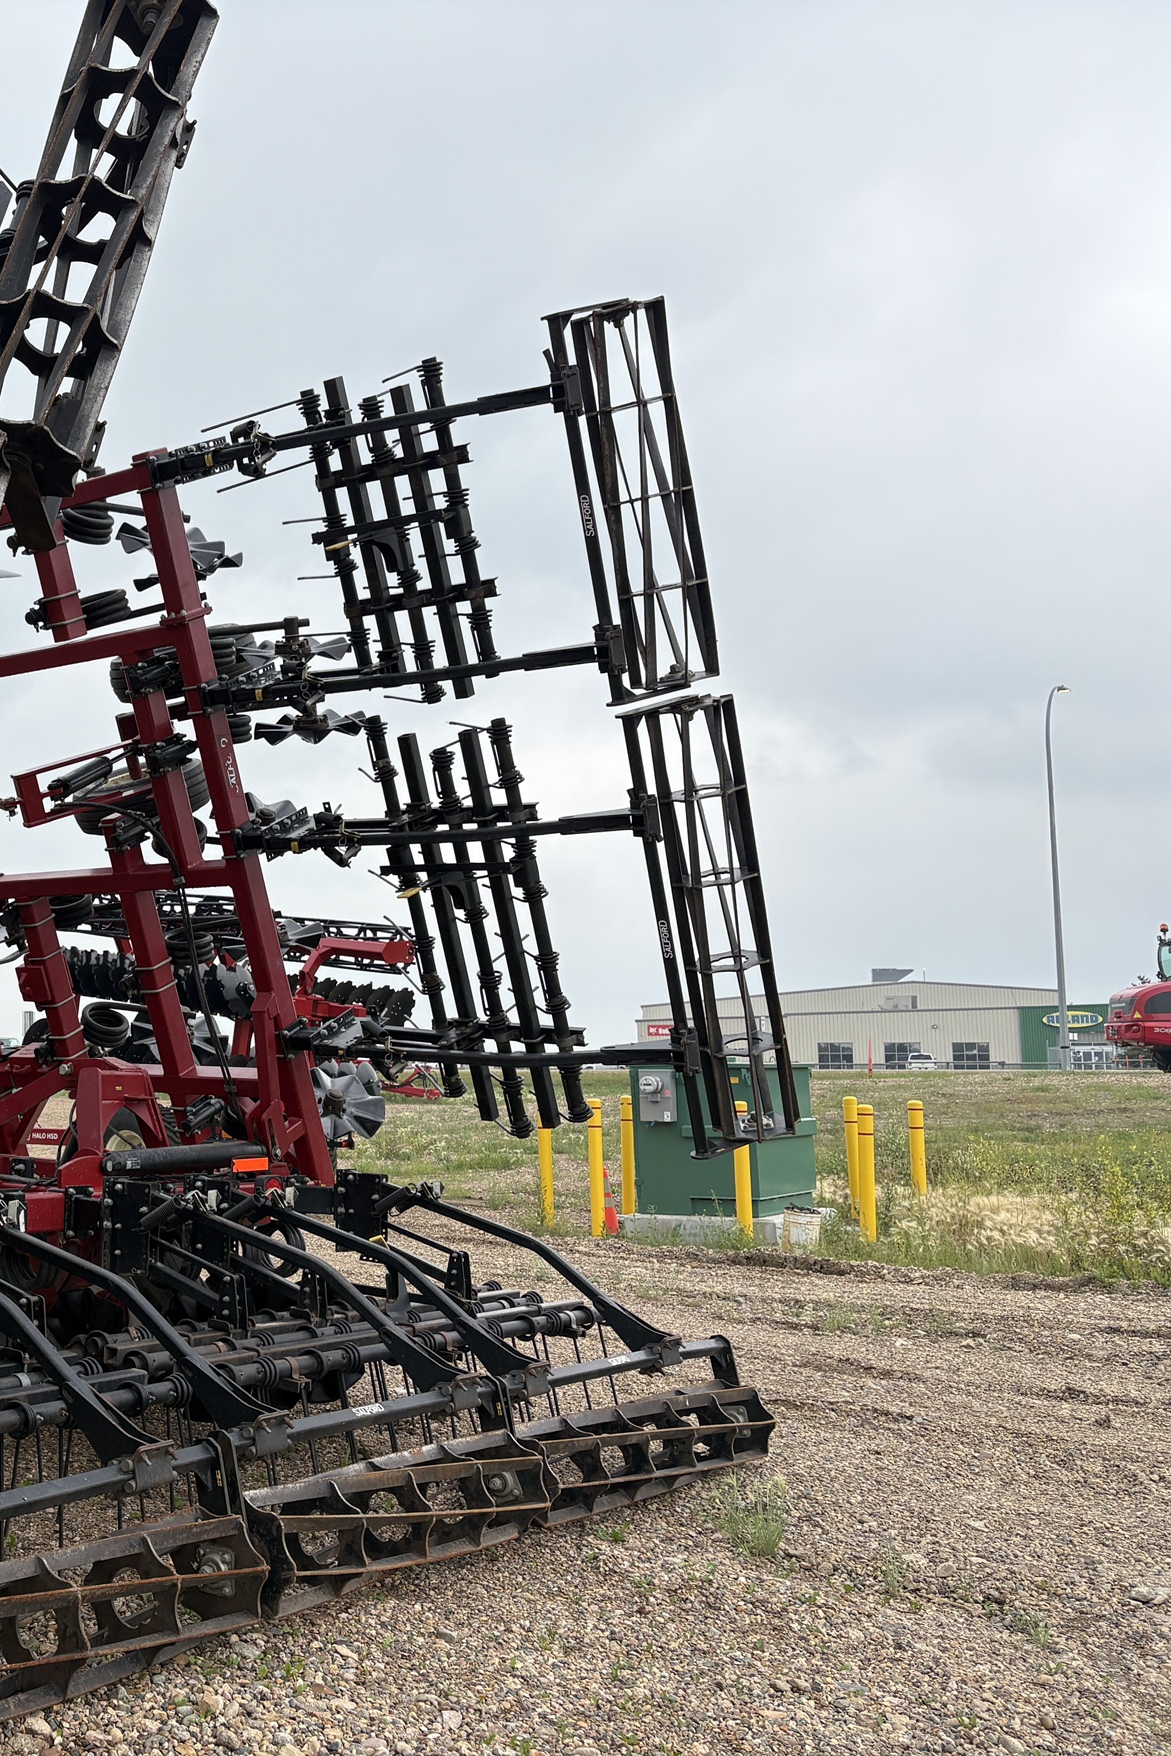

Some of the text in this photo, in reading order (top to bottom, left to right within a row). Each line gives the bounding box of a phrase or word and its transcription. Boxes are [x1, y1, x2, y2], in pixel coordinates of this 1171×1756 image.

[580, 494, 595, 537] SALFORD
[658, 919, 674, 959] SALFORD
[1046, 1014, 1099, 1025] AAND
[31, 1132, 47, 1140] HALO
